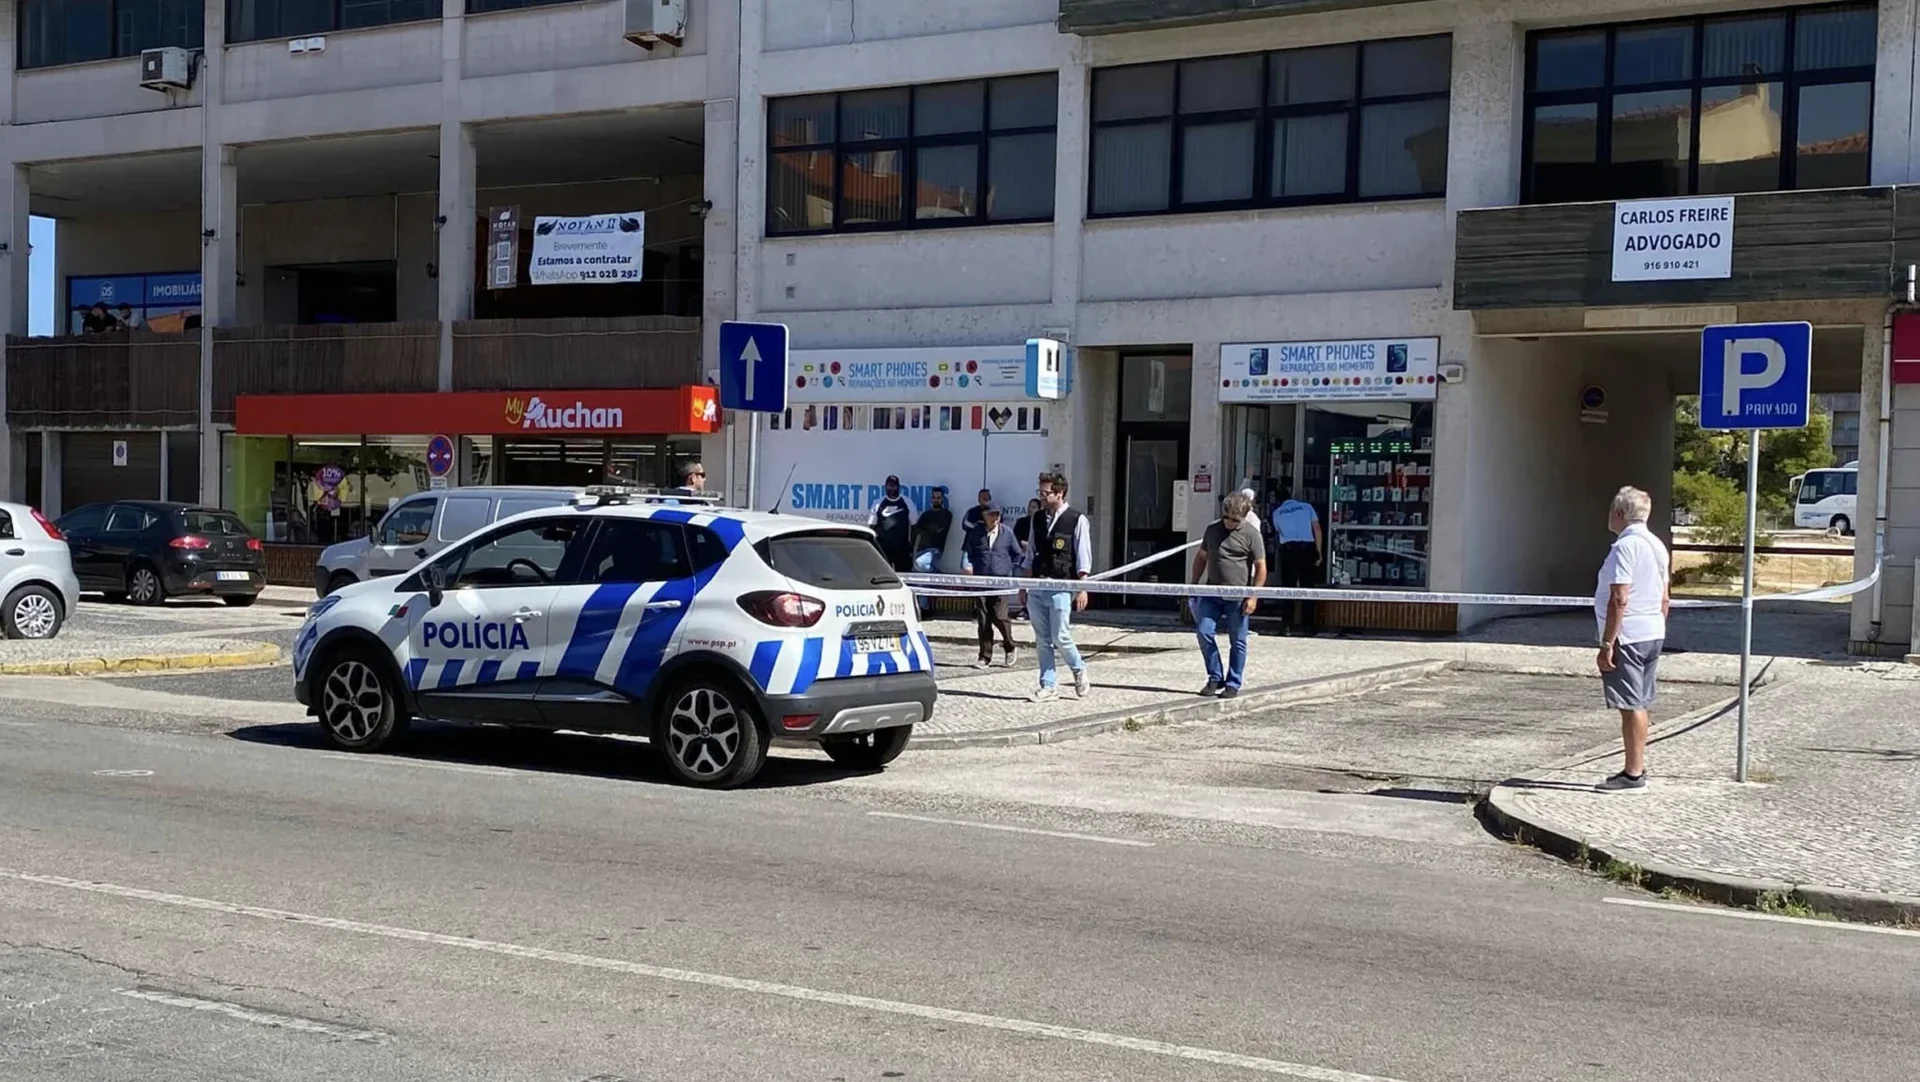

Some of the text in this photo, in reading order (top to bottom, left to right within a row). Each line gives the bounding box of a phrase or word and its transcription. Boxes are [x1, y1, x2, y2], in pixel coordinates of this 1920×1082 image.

[1620, 207, 1729, 225] CARLOS FREIRE
[1625, 232, 1721, 251] ADVOGADO
[537, 256, 574, 265] Estamos
[583, 254, 632, 264] contratar
[1643, 260, 1699, 270] 916 910 421
[579, 270, 597, 280] 912
[600, 268, 618, 279] 028
[620, 269, 638, 279] 292
[1280, 344, 1375, 362] SMART PHONES
[849, 361, 928, 379] SMART PHONES
[1722, 337, 1786, 416] P
[505, 396, 622, 428] My Auchan
[1745, 403, 1797, 415] PRIVADO
[792, 483, 863, 510] SMART
[423, 615, 529, 650] POLÍCIA
